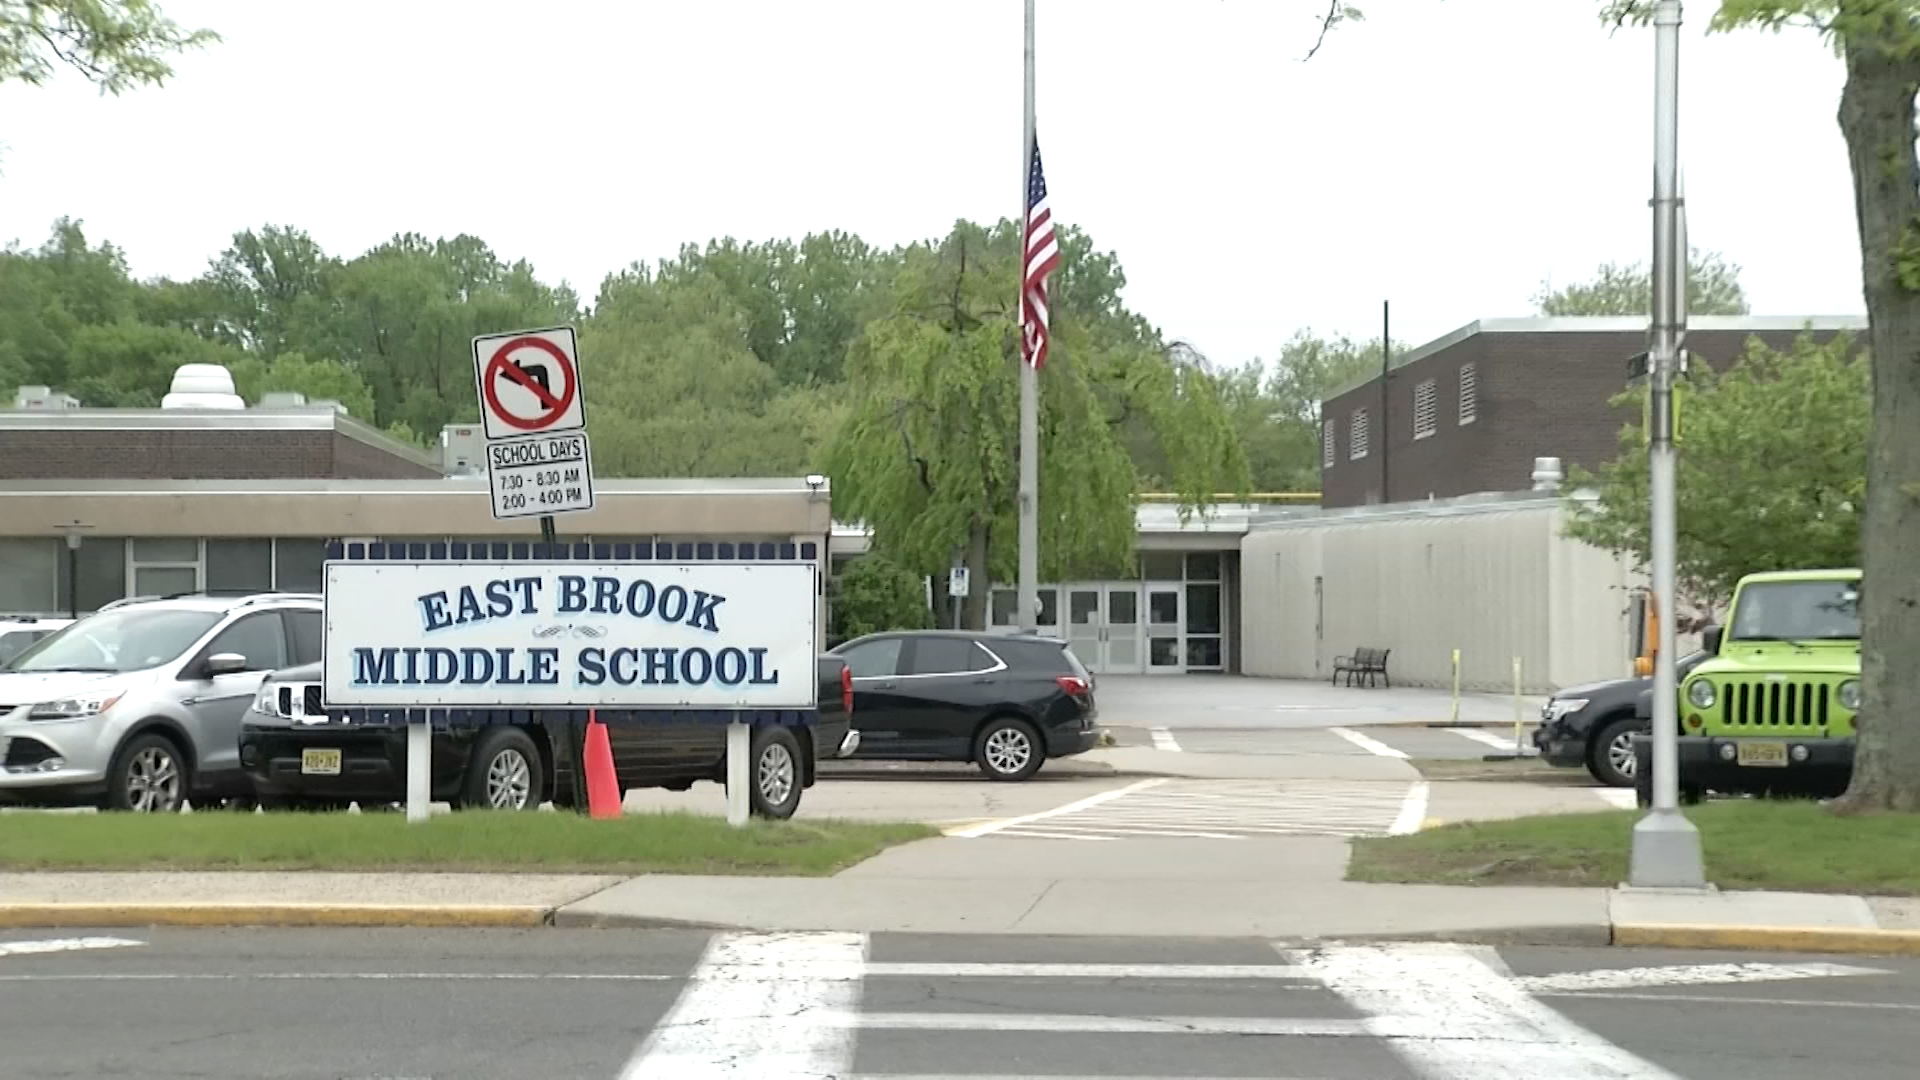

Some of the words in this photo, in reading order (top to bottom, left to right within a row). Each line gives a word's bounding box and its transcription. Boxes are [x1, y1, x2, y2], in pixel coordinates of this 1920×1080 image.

[493, 443, 546, 464] SCHOOL
[550, 439, 580, 458] DAYS
[500, 473, 523, 490] 7:30
[536, 469, 560, 486] 8:30
[564, 467, 580, 484] AM
[502, 493, 526, 510] 2:00
[540, 489, 563, 504] 4:00
[565, 487, 582, 502] PM
[417, 577, 543, 632] EAST
[557, 575, 726, 633] BROOK
[353, 647, 559, 686] MIDDLE
[577, 647, 780, 686] SCHOOL
